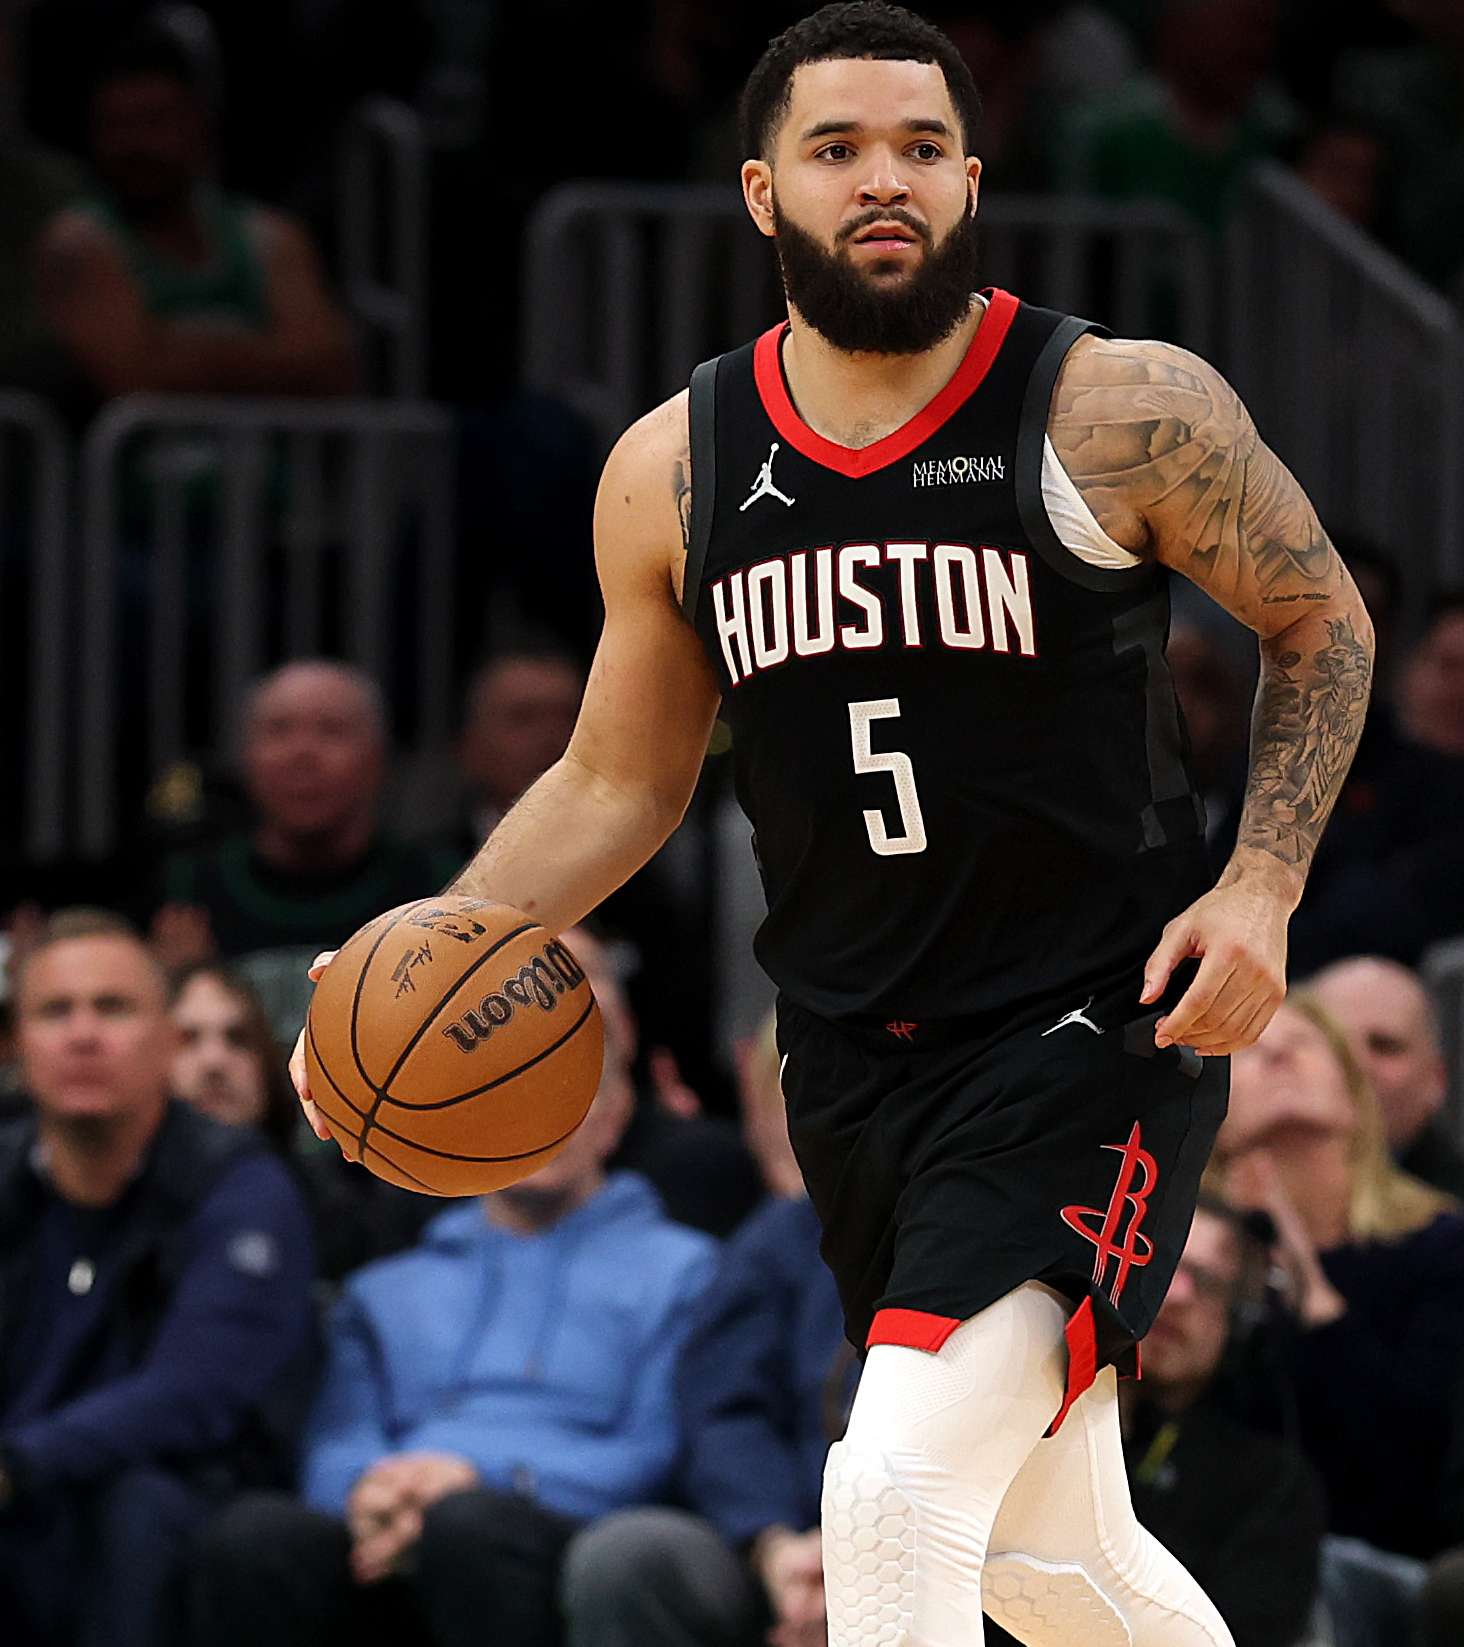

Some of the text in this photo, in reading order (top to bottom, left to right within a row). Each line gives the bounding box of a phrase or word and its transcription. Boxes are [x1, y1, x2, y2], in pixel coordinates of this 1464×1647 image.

[912, 455, 1006, 475] MEMORIAL
[912, 467, 1005, 488] HERMANN
[711, 541, 1038, 687] HOUSTON
[848, 698, 928, 856] 5
